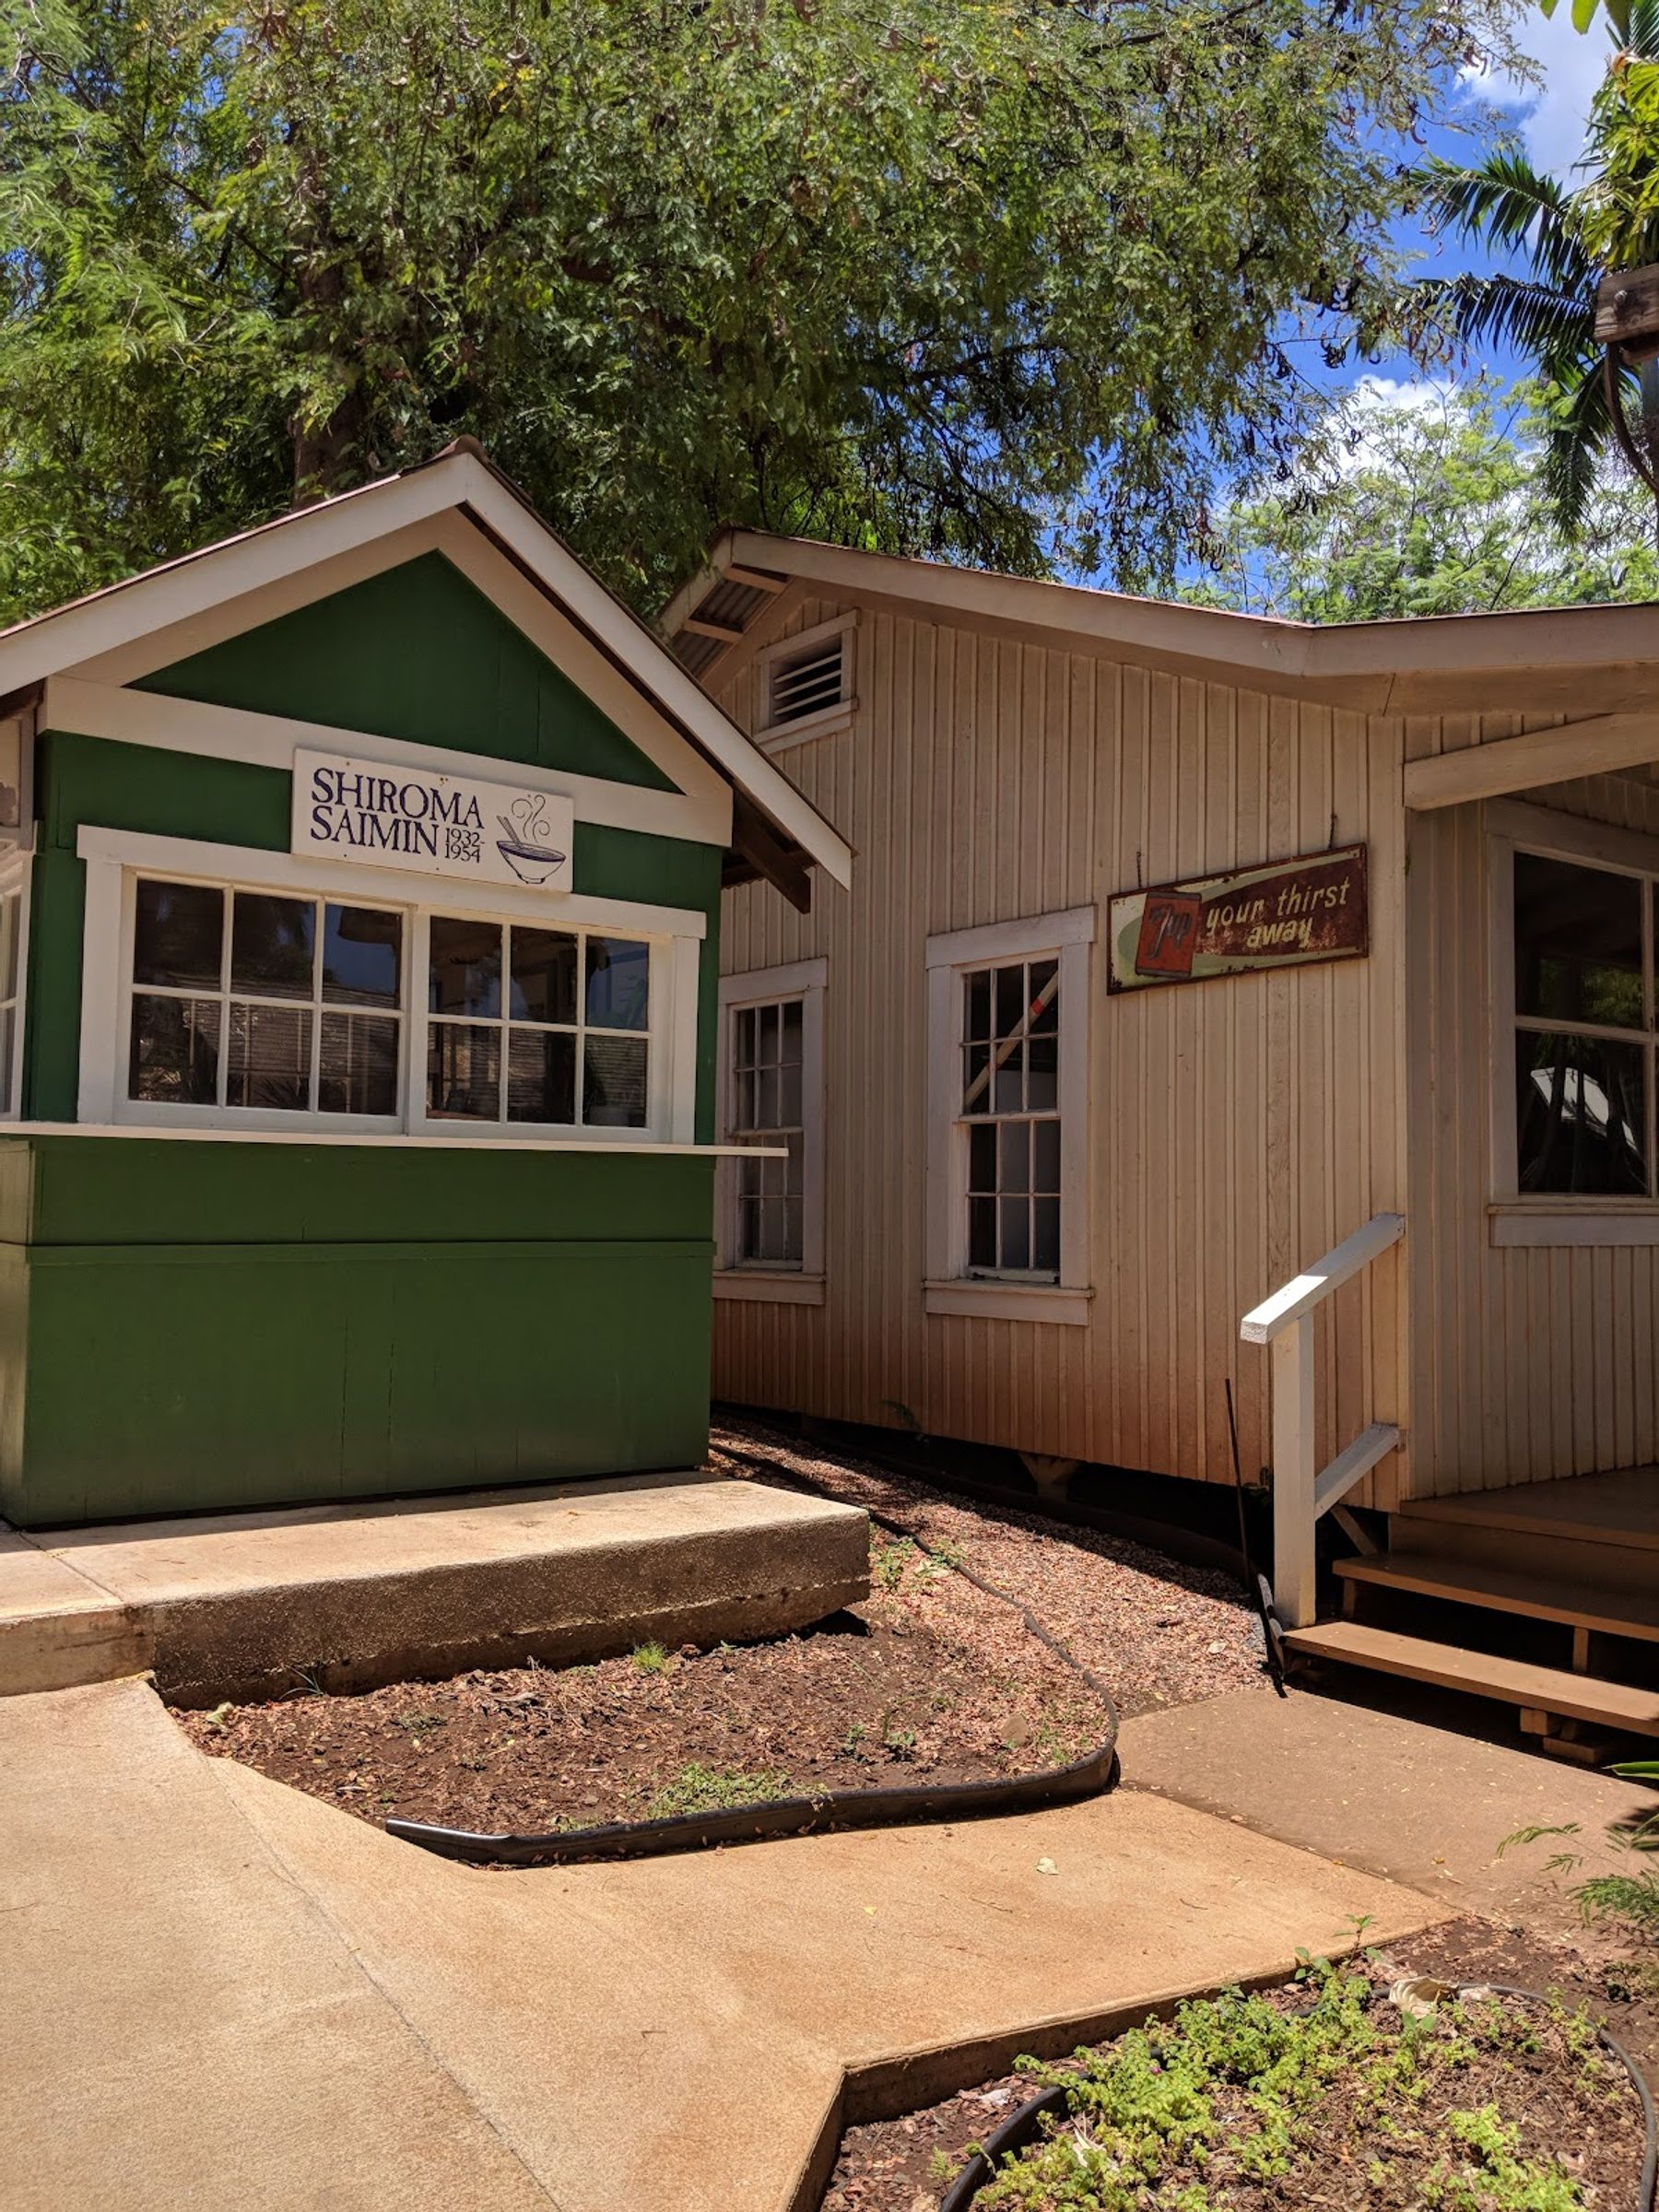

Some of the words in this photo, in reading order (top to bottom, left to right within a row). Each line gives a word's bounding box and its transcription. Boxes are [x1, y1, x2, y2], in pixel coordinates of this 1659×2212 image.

[312, 768, 485, 829] SHIROMA
[311, 806, 440, 856] SAIMIN
[444, 843, 480, 863] 1954
[1206, 899, 1265, 936] your
[1277, 877, 1350, 916] thirst
[1246, 916, 1312, 948] away
